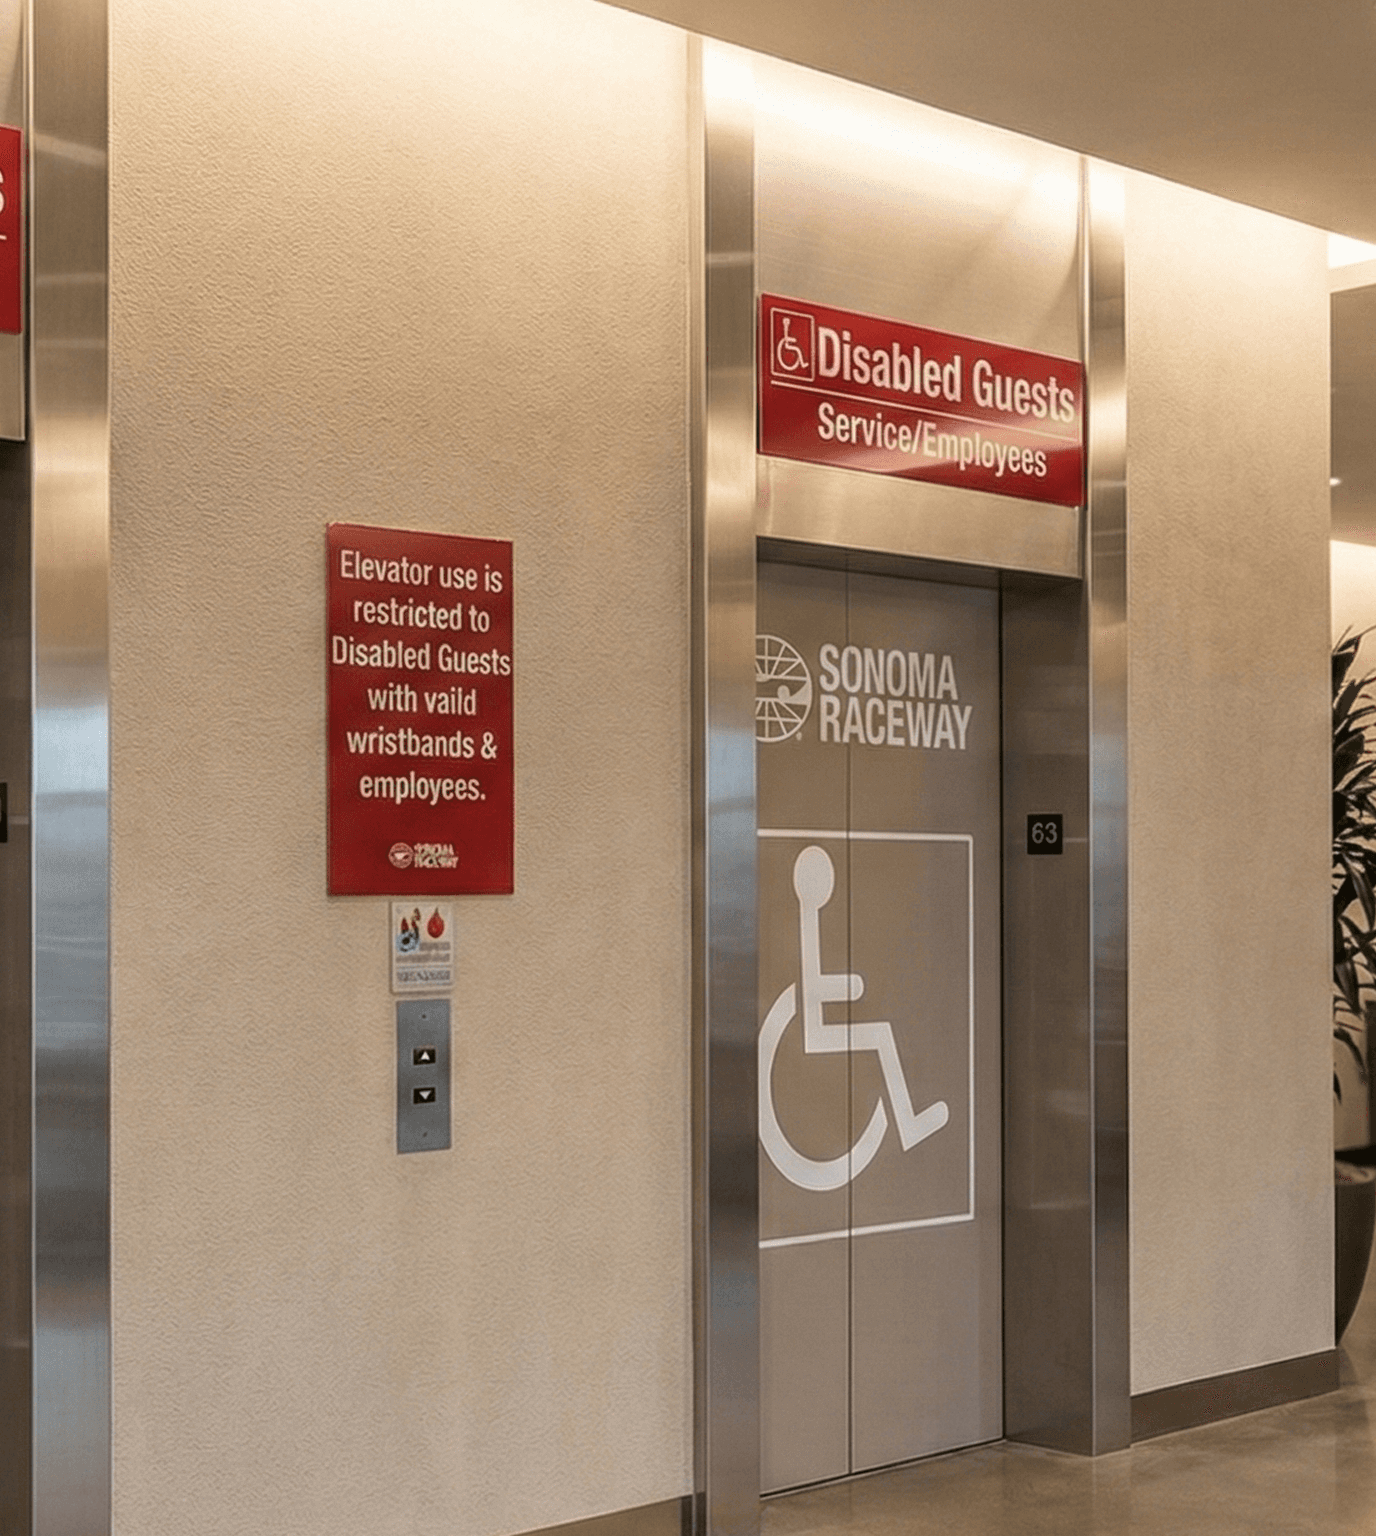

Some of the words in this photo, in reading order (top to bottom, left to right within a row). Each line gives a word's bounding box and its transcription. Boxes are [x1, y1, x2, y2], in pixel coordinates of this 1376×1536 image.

[817, 326, 962, 402] Disabled
[973, 358, 1075, 424] Guests
[817, 402, 1048, 478] Service/Employees
[340, 549, 433, 586] Elevator
[439, 567, 479, 592] use
[484, 564, 504, 593] is
[353, 598, 463, 631] restricted
[469, 604, 491, 633] to
[332, 635, 431, 672] Disabled
[438, 644, 512, 676] Guests
[819, 643, 959, 701] SONOMA
[367, 682, 418, 713] with
[424, 687, 478, 716] vaild
[820, 694, 973, 750] RACEWAY
[346, 727, 475, 759] wristbands
[480, 732, 498, 760] &
[359, 771, 487, 806] employees.
[1031, 821, 1058, 845] 63
